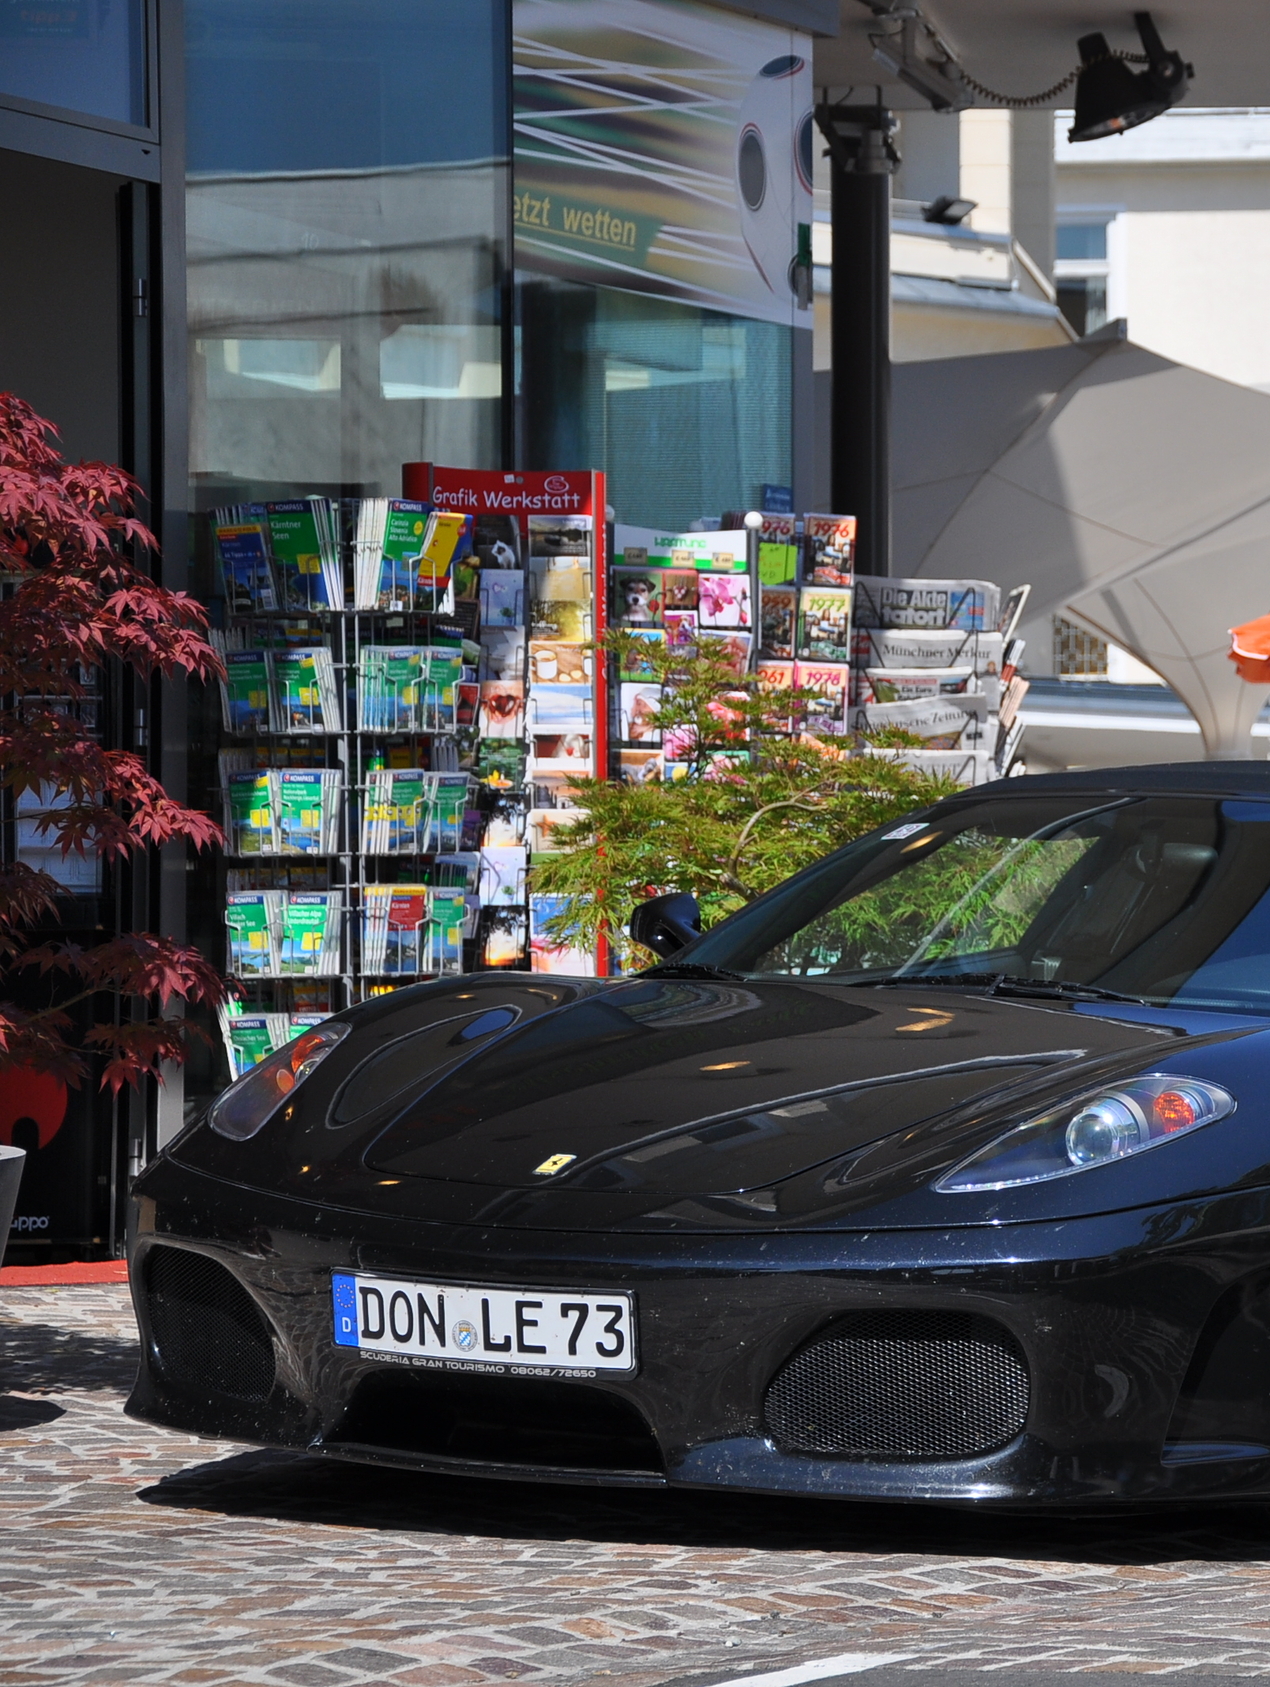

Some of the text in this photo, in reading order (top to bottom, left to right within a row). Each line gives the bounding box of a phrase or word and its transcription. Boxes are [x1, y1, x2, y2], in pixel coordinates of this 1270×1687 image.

[563, 205, 637, 246] wetten
[433, 486, 581, 509] Grafik Werkstatt
[275, 503, 304, 511] KOMPASS
[400, 502, 422, 511] KOMPASS
[270, 521, 301, 529] Kärntner
[272, 532, 290, 540] Seen
[809, 597, 846, 612] 1977
[882, 587, 947, 607] Die Akte
[882, 608, 946, 626] tatort
[883, 644, 992, 660] Münchner Merkur
[290, 774, 314, 782] KOMPASS
[234, 896, 258, 904] KOMPASS
[297, 896, 321, 904] KOMPASS
[236, 1020, 260, 1028] KOMPASS
[342, 1316, 352, 1333] D
[359, 1286, 446, 1348] DON
[481, 1298, 547, 1354] LE
[560, 1302, 625, 1358] 73
[360, 1351, 597, 1378] SCUDERIA GRAN TOURISMO 08062/72650
